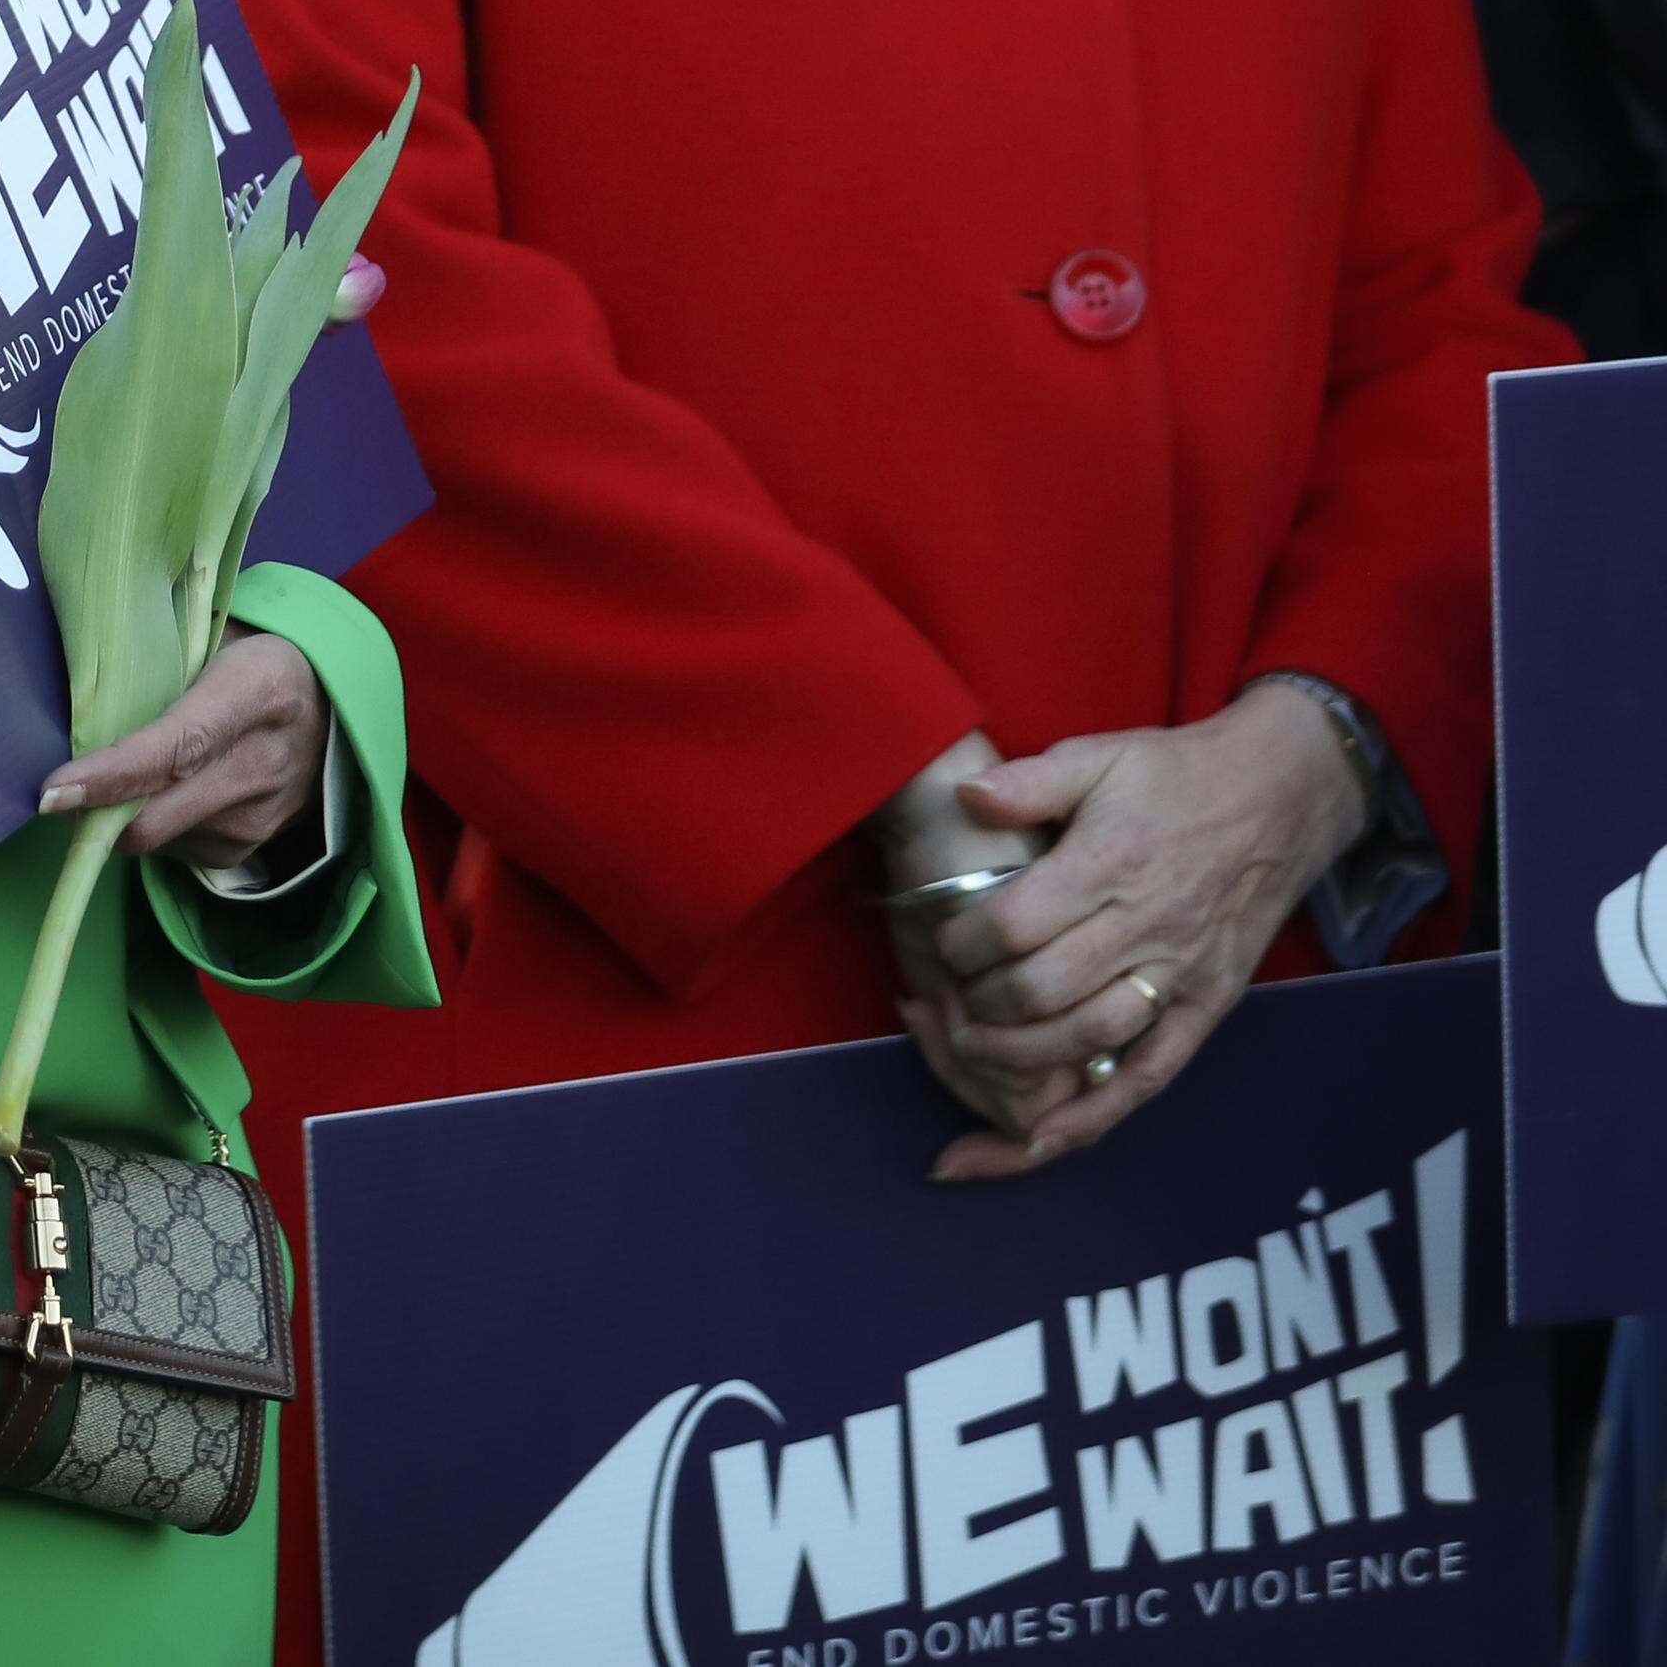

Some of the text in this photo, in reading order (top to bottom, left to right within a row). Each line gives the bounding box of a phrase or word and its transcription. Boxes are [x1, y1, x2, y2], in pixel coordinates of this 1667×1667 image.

[42, 263, 131, 356] DOMEST
[709, 1187, 1402, 1635] WE WON'T
[882, 1587, 1170, 1667] DOMESTIC
[1192, 1540, 1467, 1618] VIOLENCE
